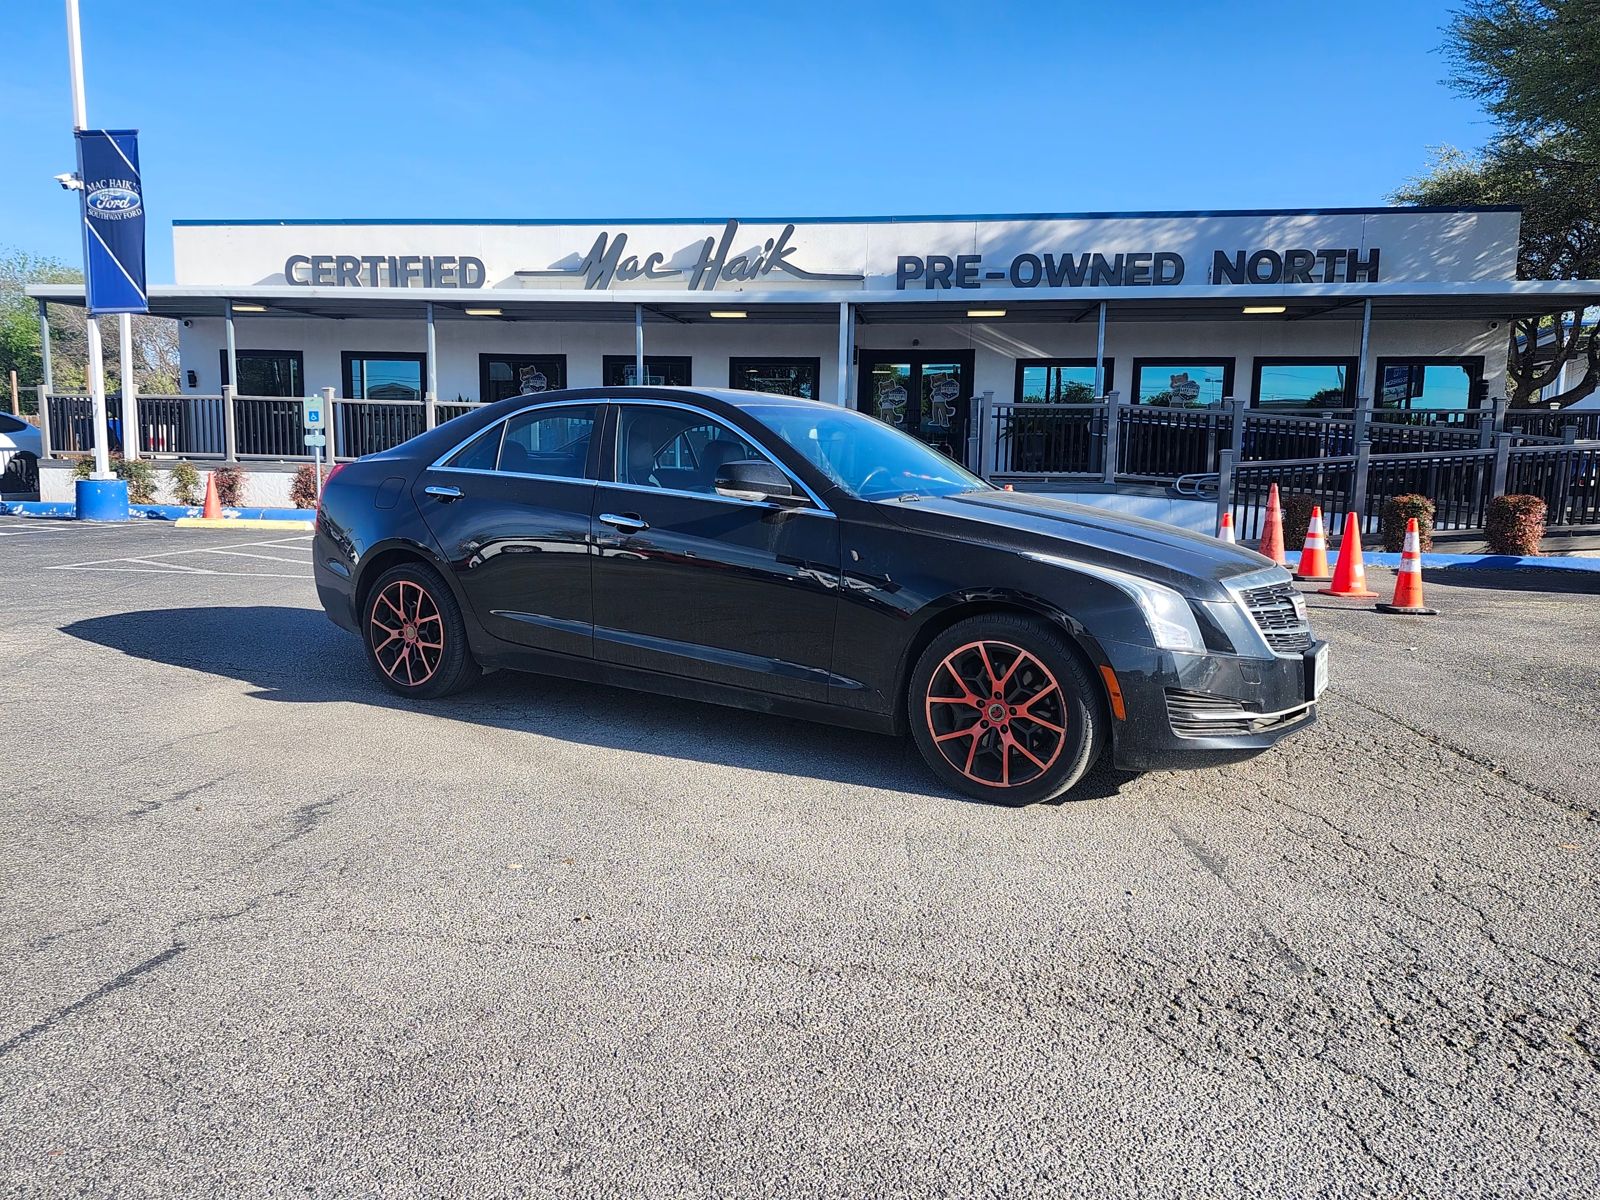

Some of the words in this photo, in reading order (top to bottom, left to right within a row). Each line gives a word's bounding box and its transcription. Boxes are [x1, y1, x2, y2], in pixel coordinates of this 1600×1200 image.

[86, 180, 107, 193] MAC
[109, 179, 140, 193] HAIK'S
[97, 193, 130, 208] Ford
[88, 209, 122, 220] SOUTHWAY
[123, 208, 142, 219] FORD
[514, 231, 682, 290] Mac
[688, 219, 865, 291] Haik
[284, 254, 485, 289] CERTIFIED
[897, 252, 1185, 289] PRE-OWNED
[1212, 249, 1381, 285] NORTH
